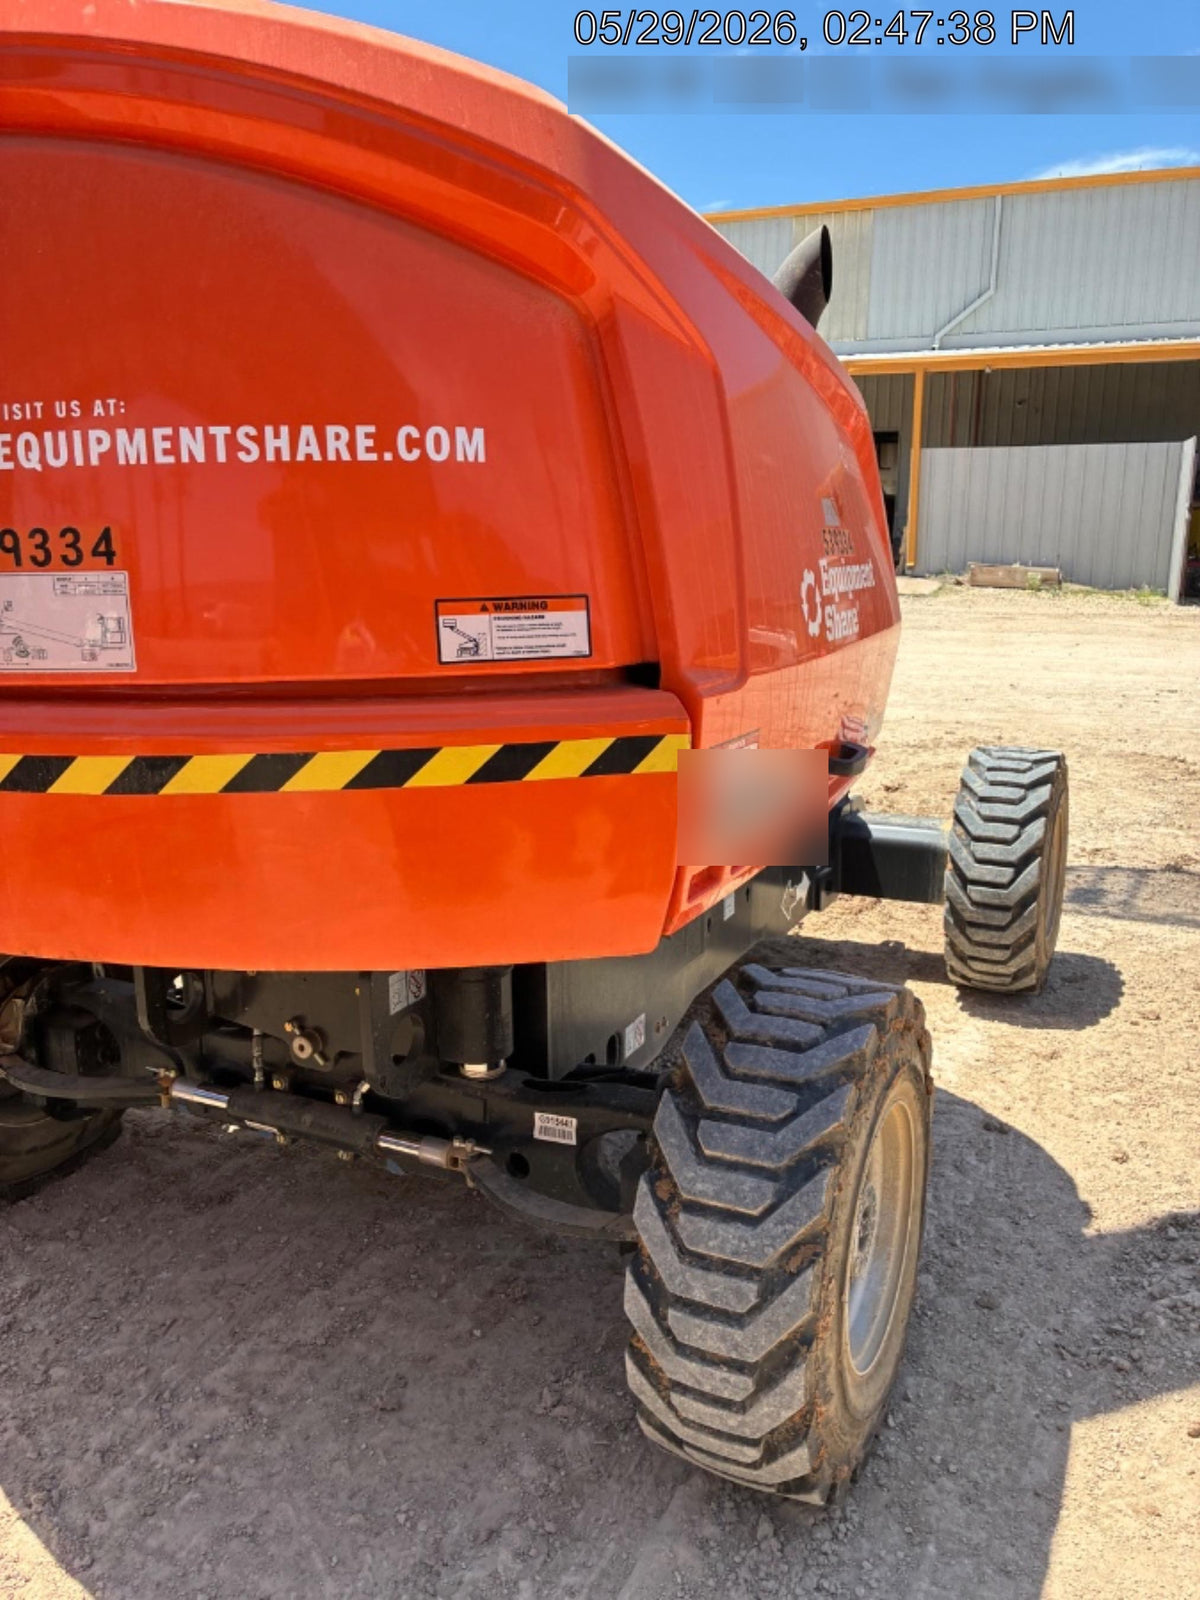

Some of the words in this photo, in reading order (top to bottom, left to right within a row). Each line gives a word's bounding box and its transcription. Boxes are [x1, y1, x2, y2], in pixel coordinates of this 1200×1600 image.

[54, 399, 82, 418] US
[93, 398, 126, 417] AT:
[0, 424, 486, 471] EQUIPMENTSHARE.COM
[0, 526, 117, 567] 9334
[819, 557, 875, 602] Equipment
[493, 600, 549, 612] WARNING
[825, 605, 859, 641] Share
